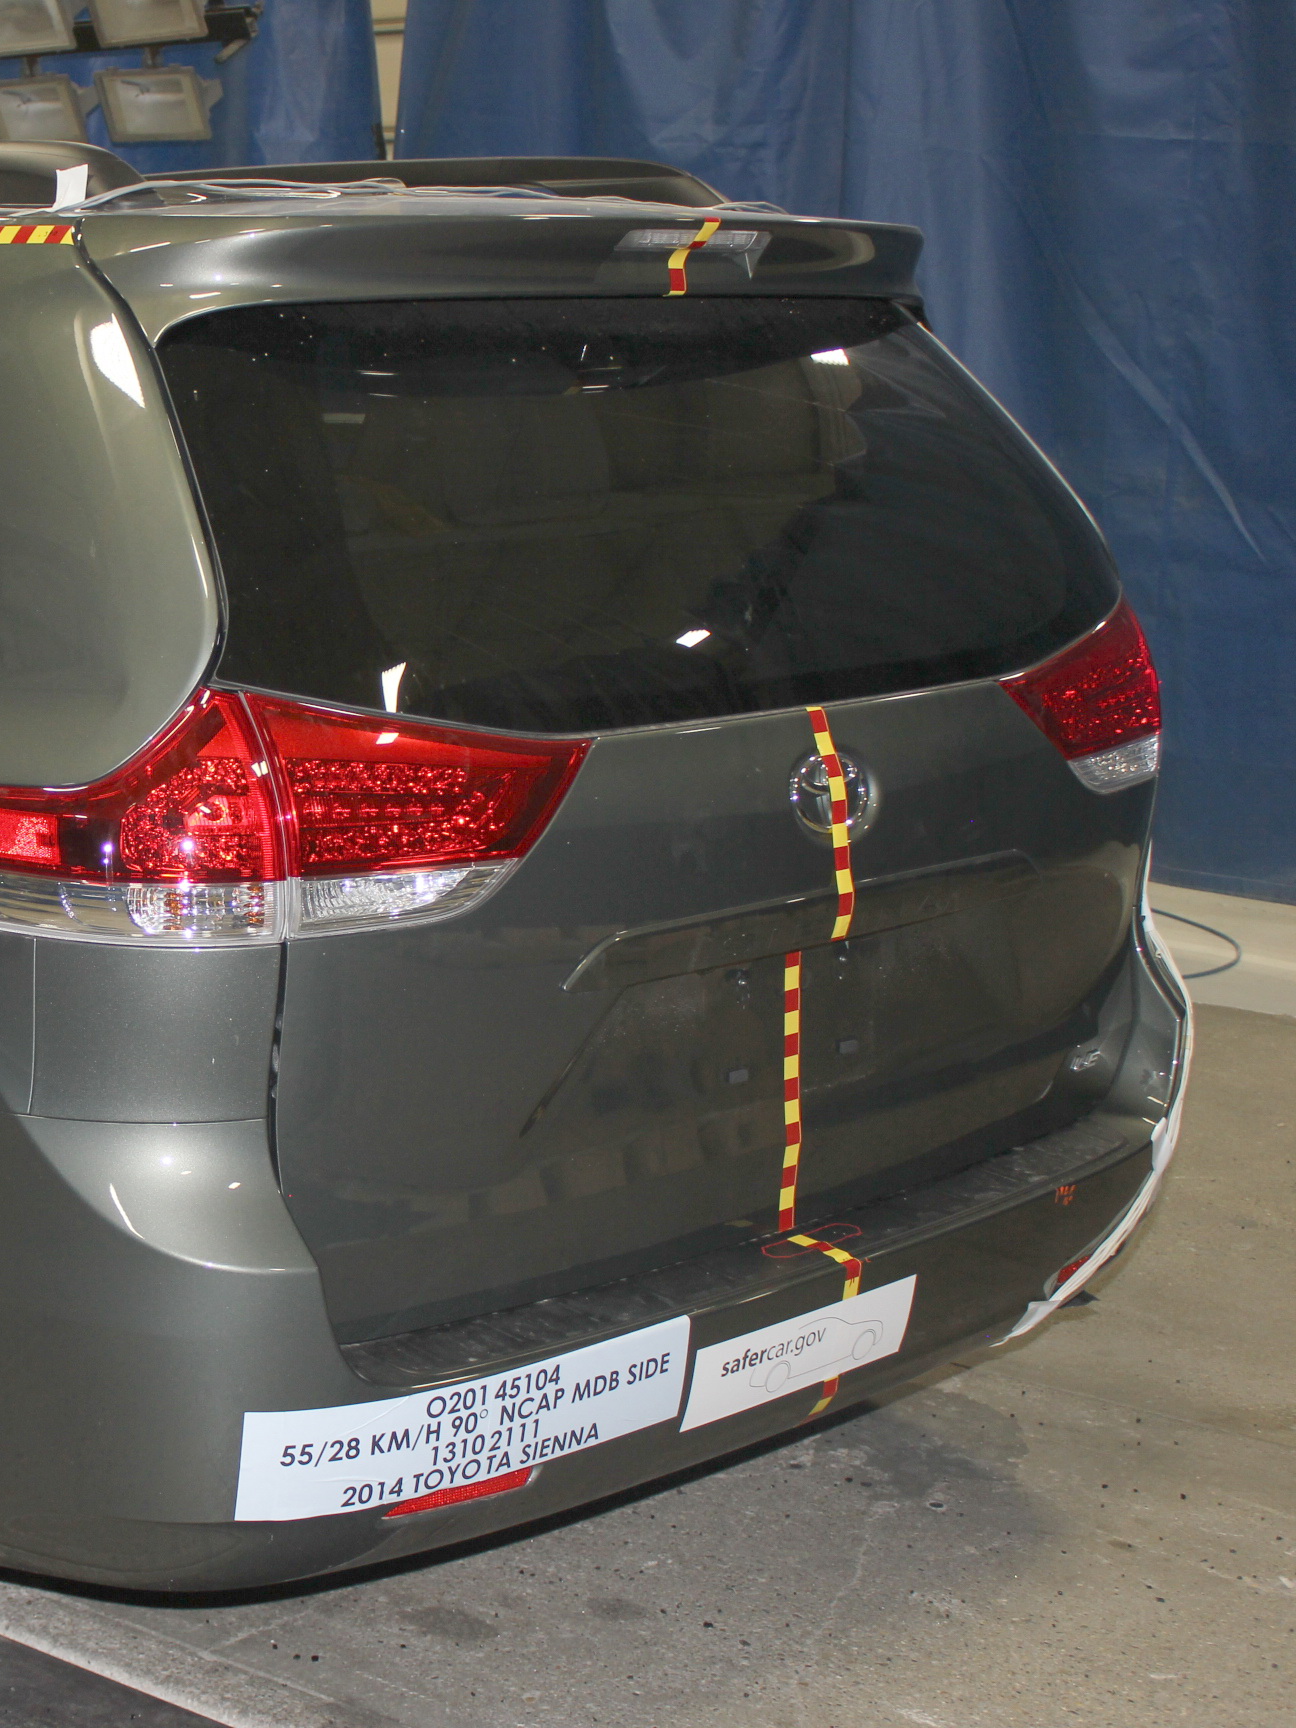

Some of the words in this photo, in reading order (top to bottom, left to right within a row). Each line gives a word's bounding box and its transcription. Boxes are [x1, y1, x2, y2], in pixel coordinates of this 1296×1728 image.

[721, 1327, 826, 1377] safercar.gov
[280, 1437, 360, 1467] 55/28
[370, 1421, 441, 1456] KM/H
[499, 1388, 565, 1425] NCAP
[571, 1370, 620, 1403] MDB
[627, 1352, 670, 1385] SIDE
[431, 1418, 540, 1466] 13102111
[340, 1477, 403, 1507] 2014
[413, 1451, 511, 1493] TOYOTA
[519, 1422, 599, 1465] SIENNA
